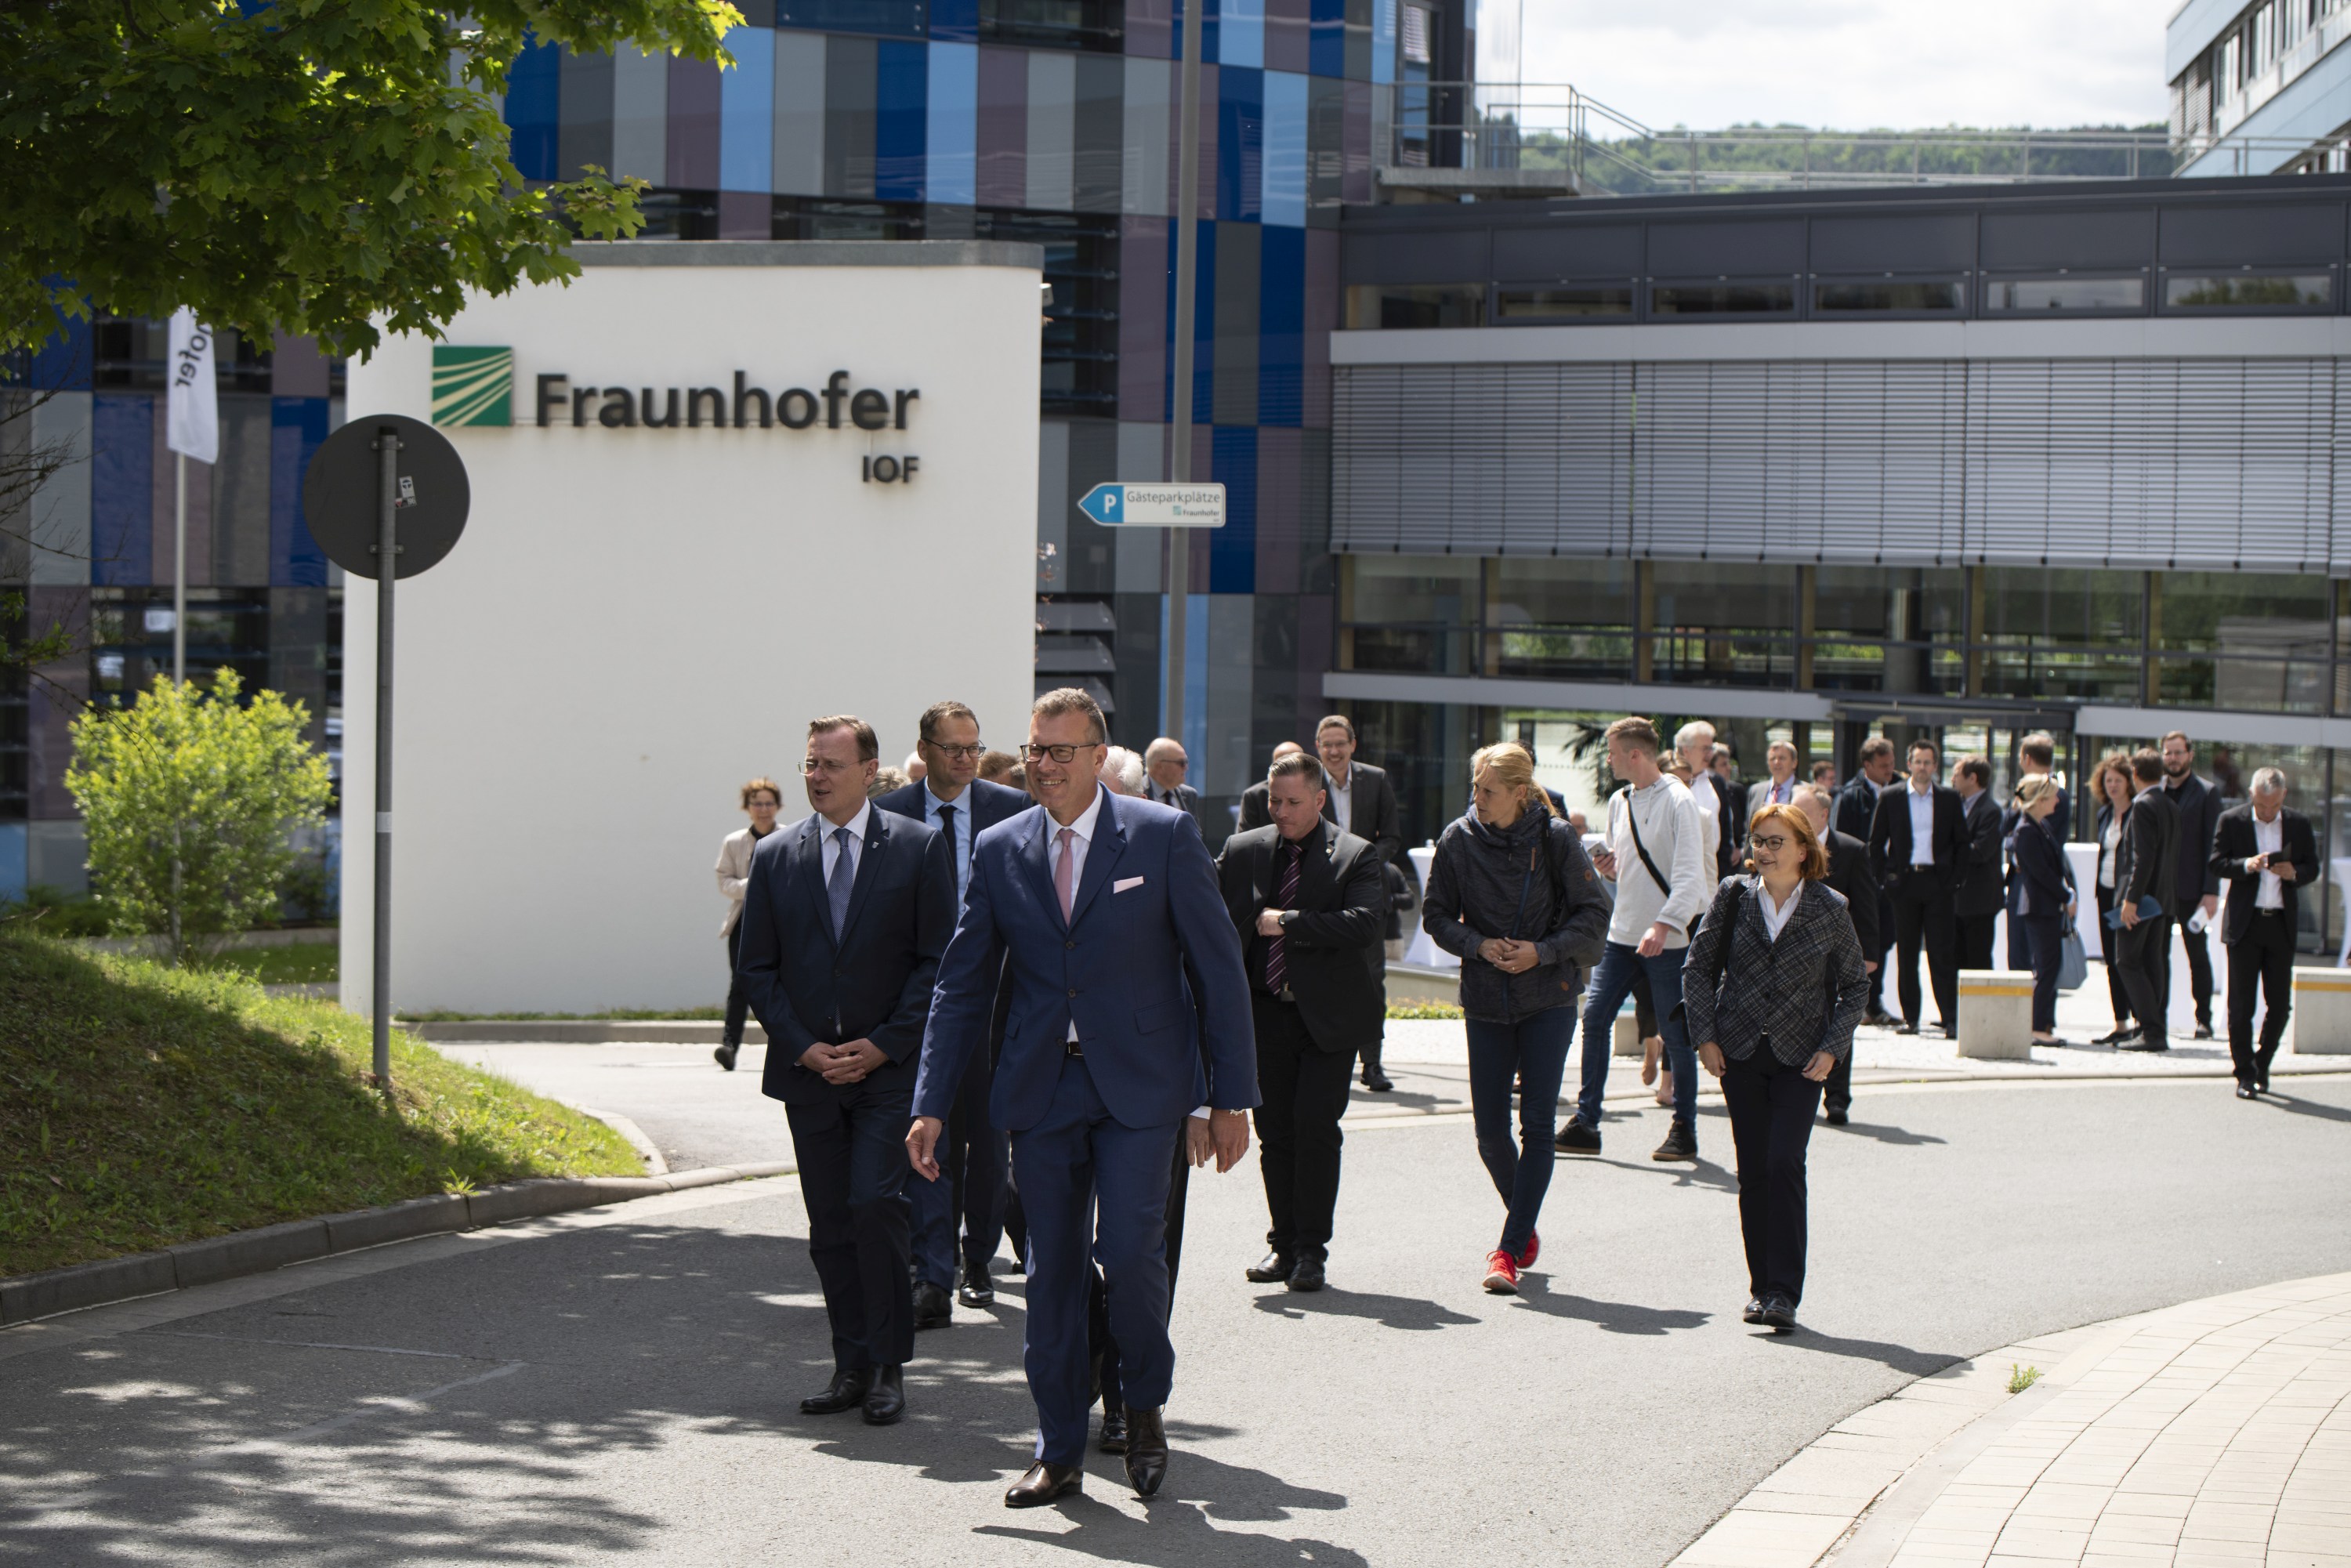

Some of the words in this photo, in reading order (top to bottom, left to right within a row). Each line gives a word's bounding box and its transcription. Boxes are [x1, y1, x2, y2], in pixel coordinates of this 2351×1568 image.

[536, 370, 920, 430] Fraunhofer
[861, 455, 919, 483] IOF
[1103, 494, 1117, 513] P
[1127, 491, 1221, 505] Gästeparkplätze
